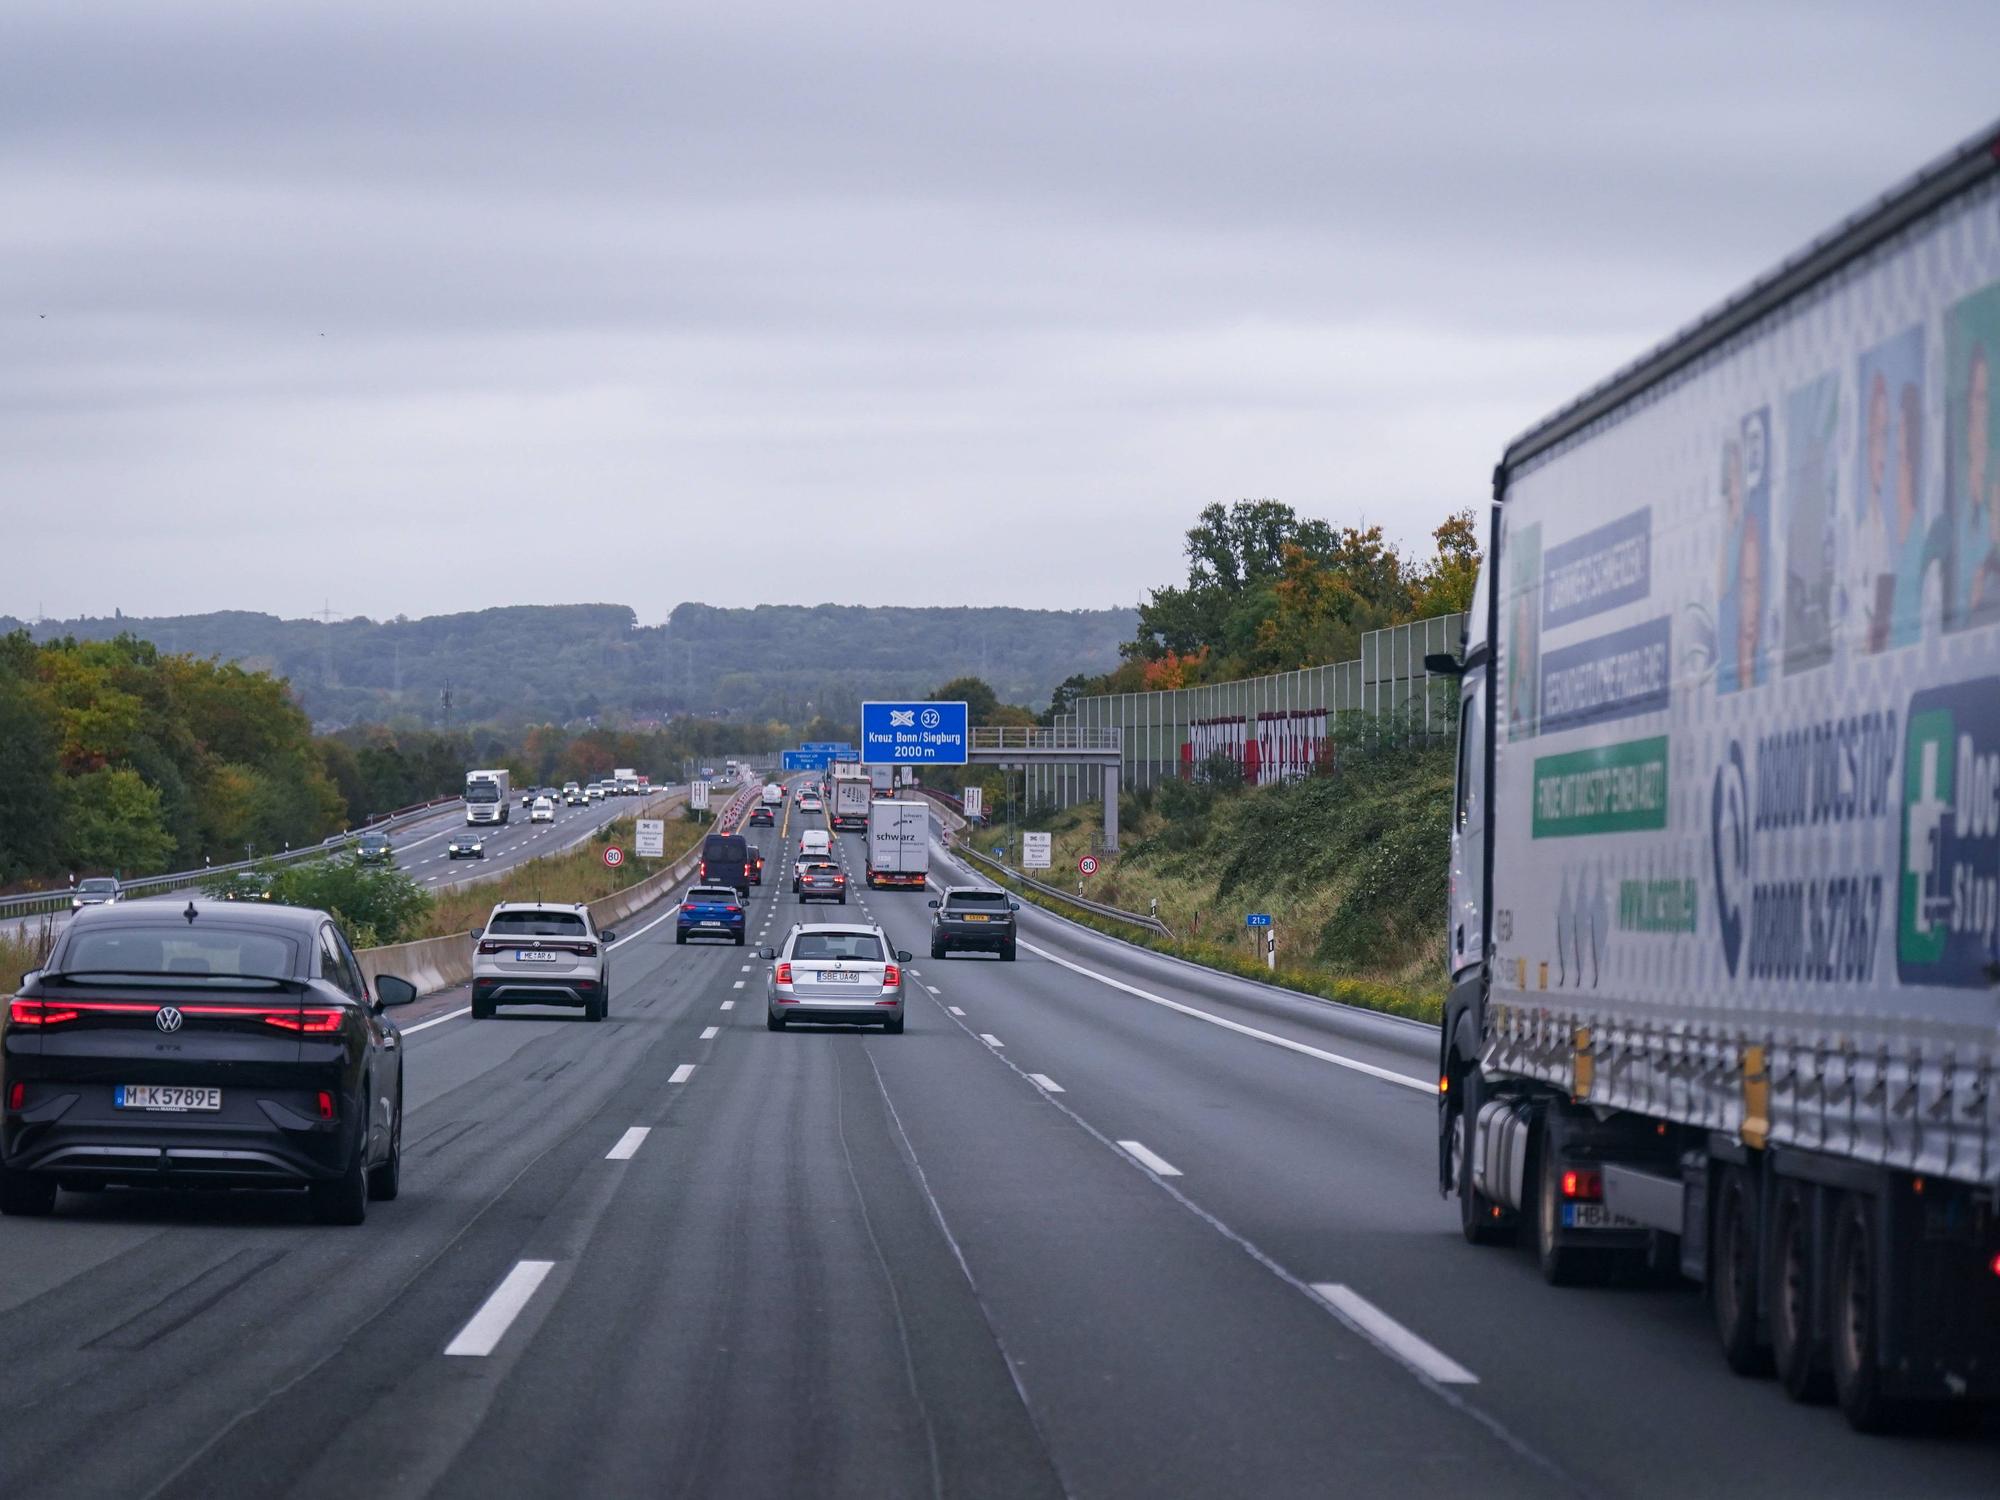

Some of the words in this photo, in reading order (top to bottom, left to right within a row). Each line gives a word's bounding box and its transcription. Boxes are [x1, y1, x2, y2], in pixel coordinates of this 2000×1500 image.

[923, 713, 937, 724] 32
[869, 732, 893, 743] Kreuz
[896, 731, 960, 745] Bonn/Siegburg
[894, 746, 922, 757] 2000
[924, 749, 935, 757] m
[876, 832, 915, 841] schwarz
[607, 852, 619, 861] 80
[1083, 861, 1094, 870] 80
[125, 1087, 138, 1104] M
